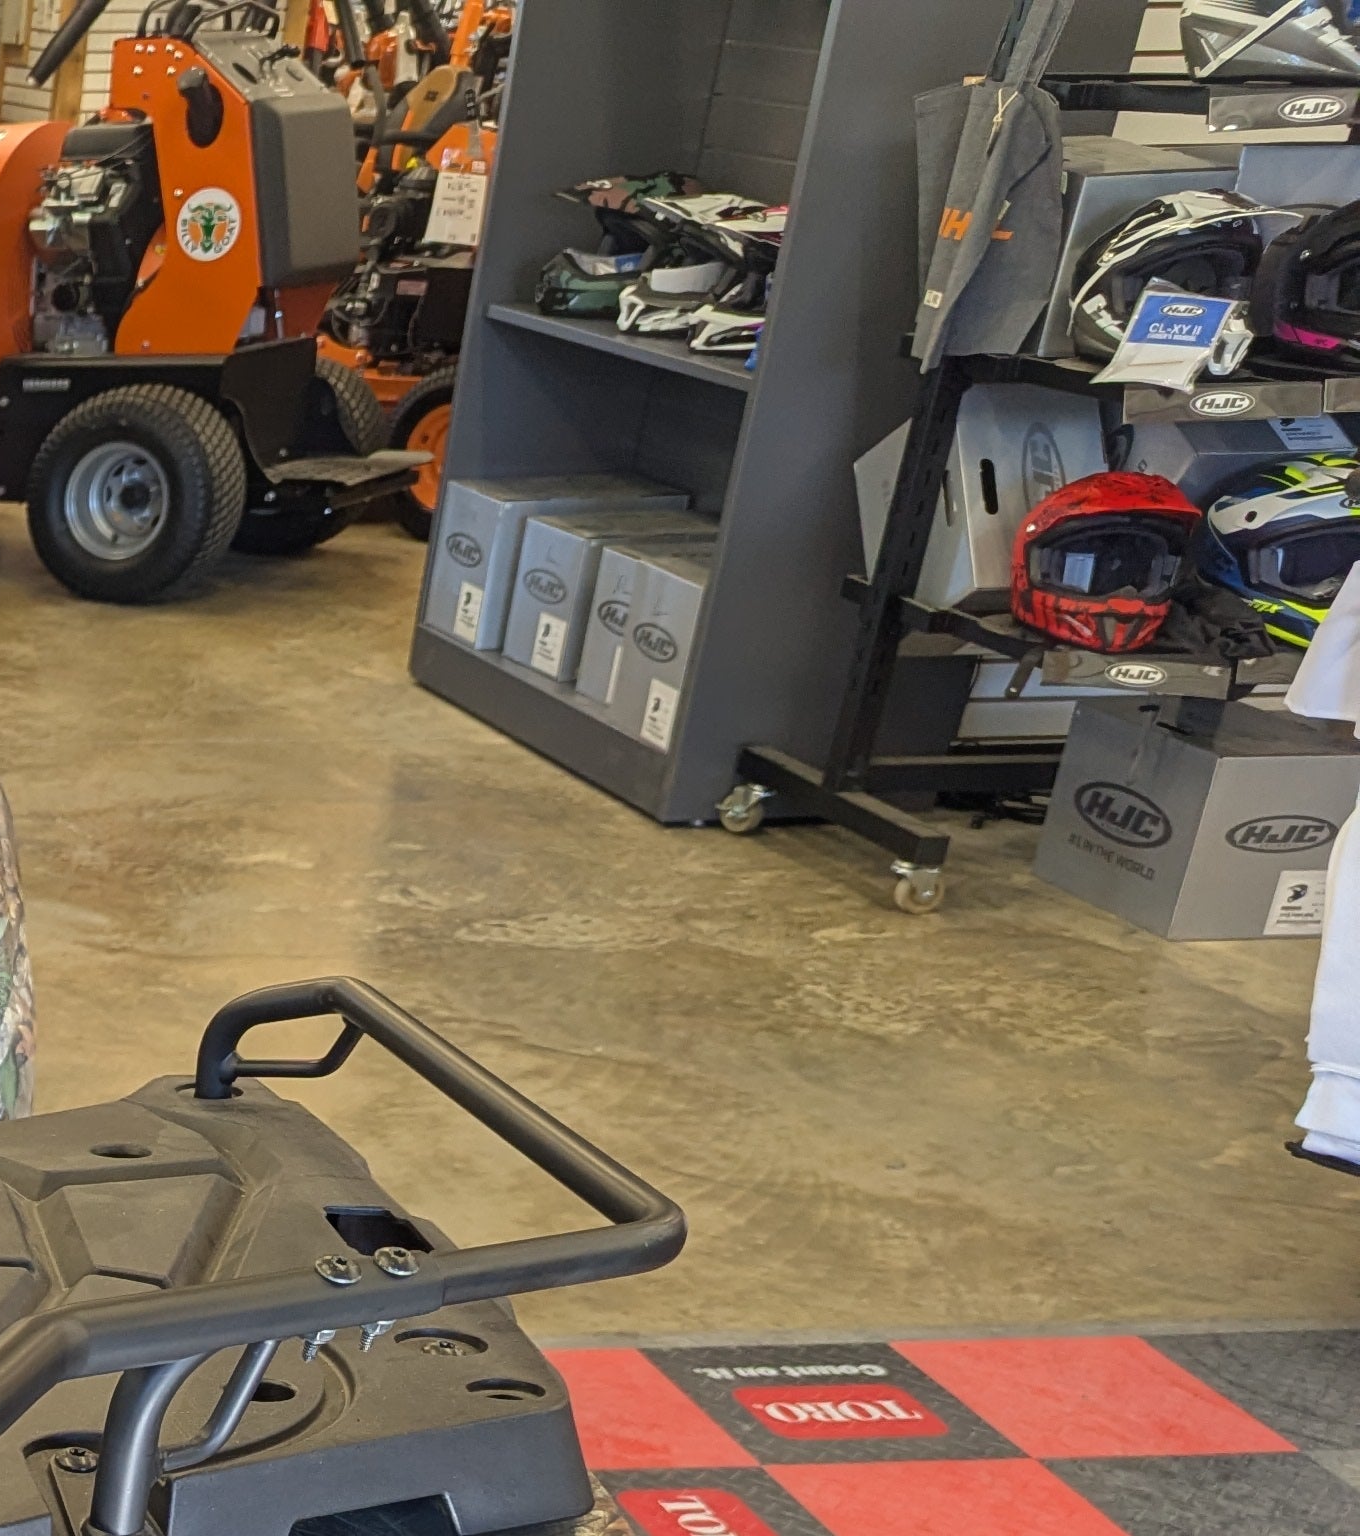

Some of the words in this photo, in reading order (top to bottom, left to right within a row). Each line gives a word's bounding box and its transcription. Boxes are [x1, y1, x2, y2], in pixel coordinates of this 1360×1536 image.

[1287, 101, 1337, 115] HJC
[1166, 306, 1201, 314] HJC
[1148, 322, 1191, 334] CL-XY
[1199, 397, 1246, 409] HJC
[1114, 668, 1159, 681] HJC
[1084, 790, 1162, 839] HJC
[1238, 824, 1327, 844] HJC
[733, 1365, 779, 1377] on
[780, 1363, 888, 1378] Count
[764, 1400, 924, 1424] TORO
